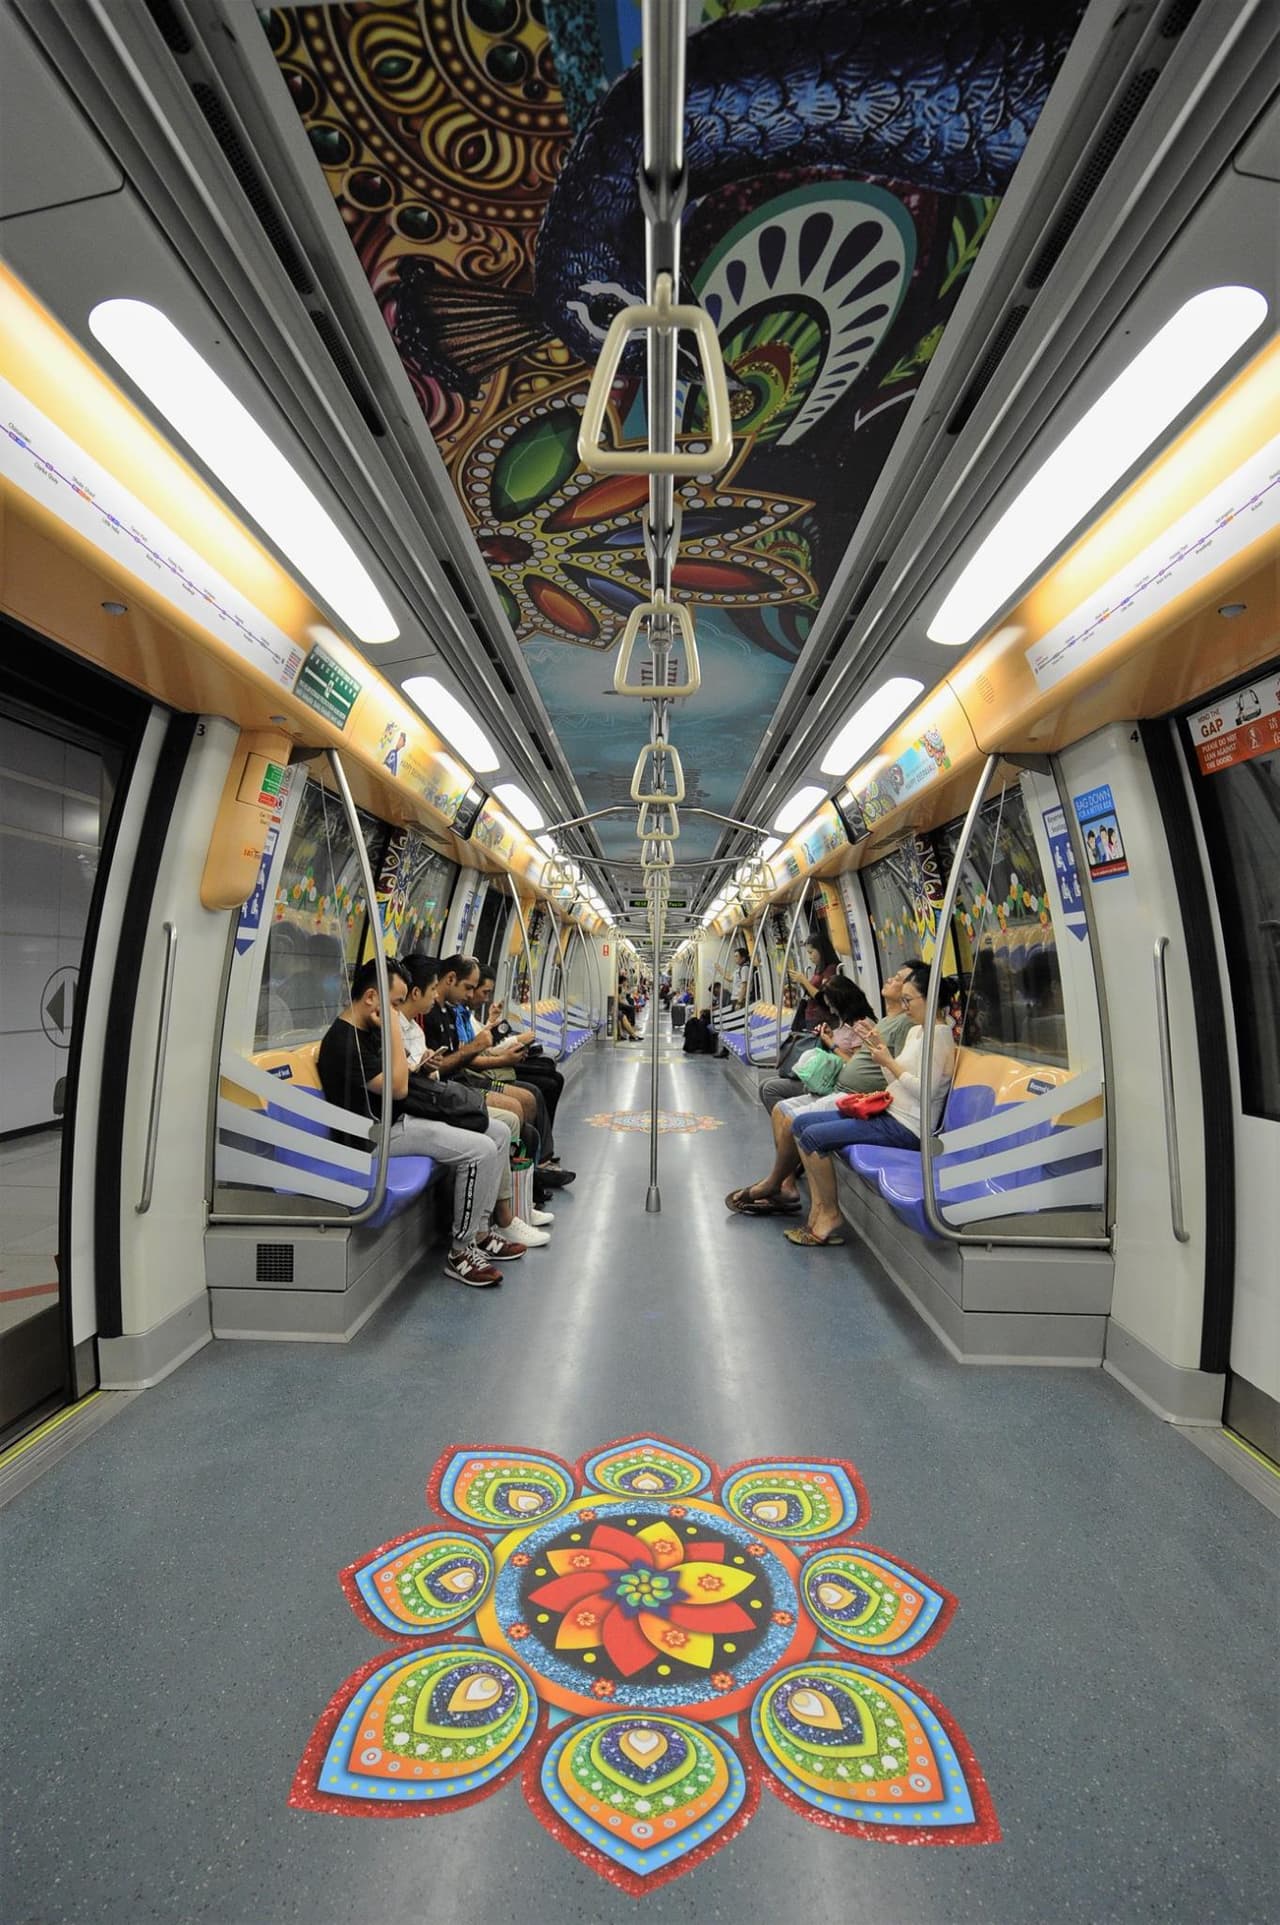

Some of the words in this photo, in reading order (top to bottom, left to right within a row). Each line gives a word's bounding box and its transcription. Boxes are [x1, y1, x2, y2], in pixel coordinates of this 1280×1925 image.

[197, 723, 205, 737] 3
[1201, 718, 1223, 737] GAP
[1130, 729, 1139, 743] 4
[1202, 741, 1218, 753] PLEASE
[1218, 738, 1227, 746] DO
[1226, 733, 1237, 743] NOT
[1088, 789, 1111, 807] DOWN
[487, 1240, 504, 1254] N
[457, 1260, 473, 1276] N
